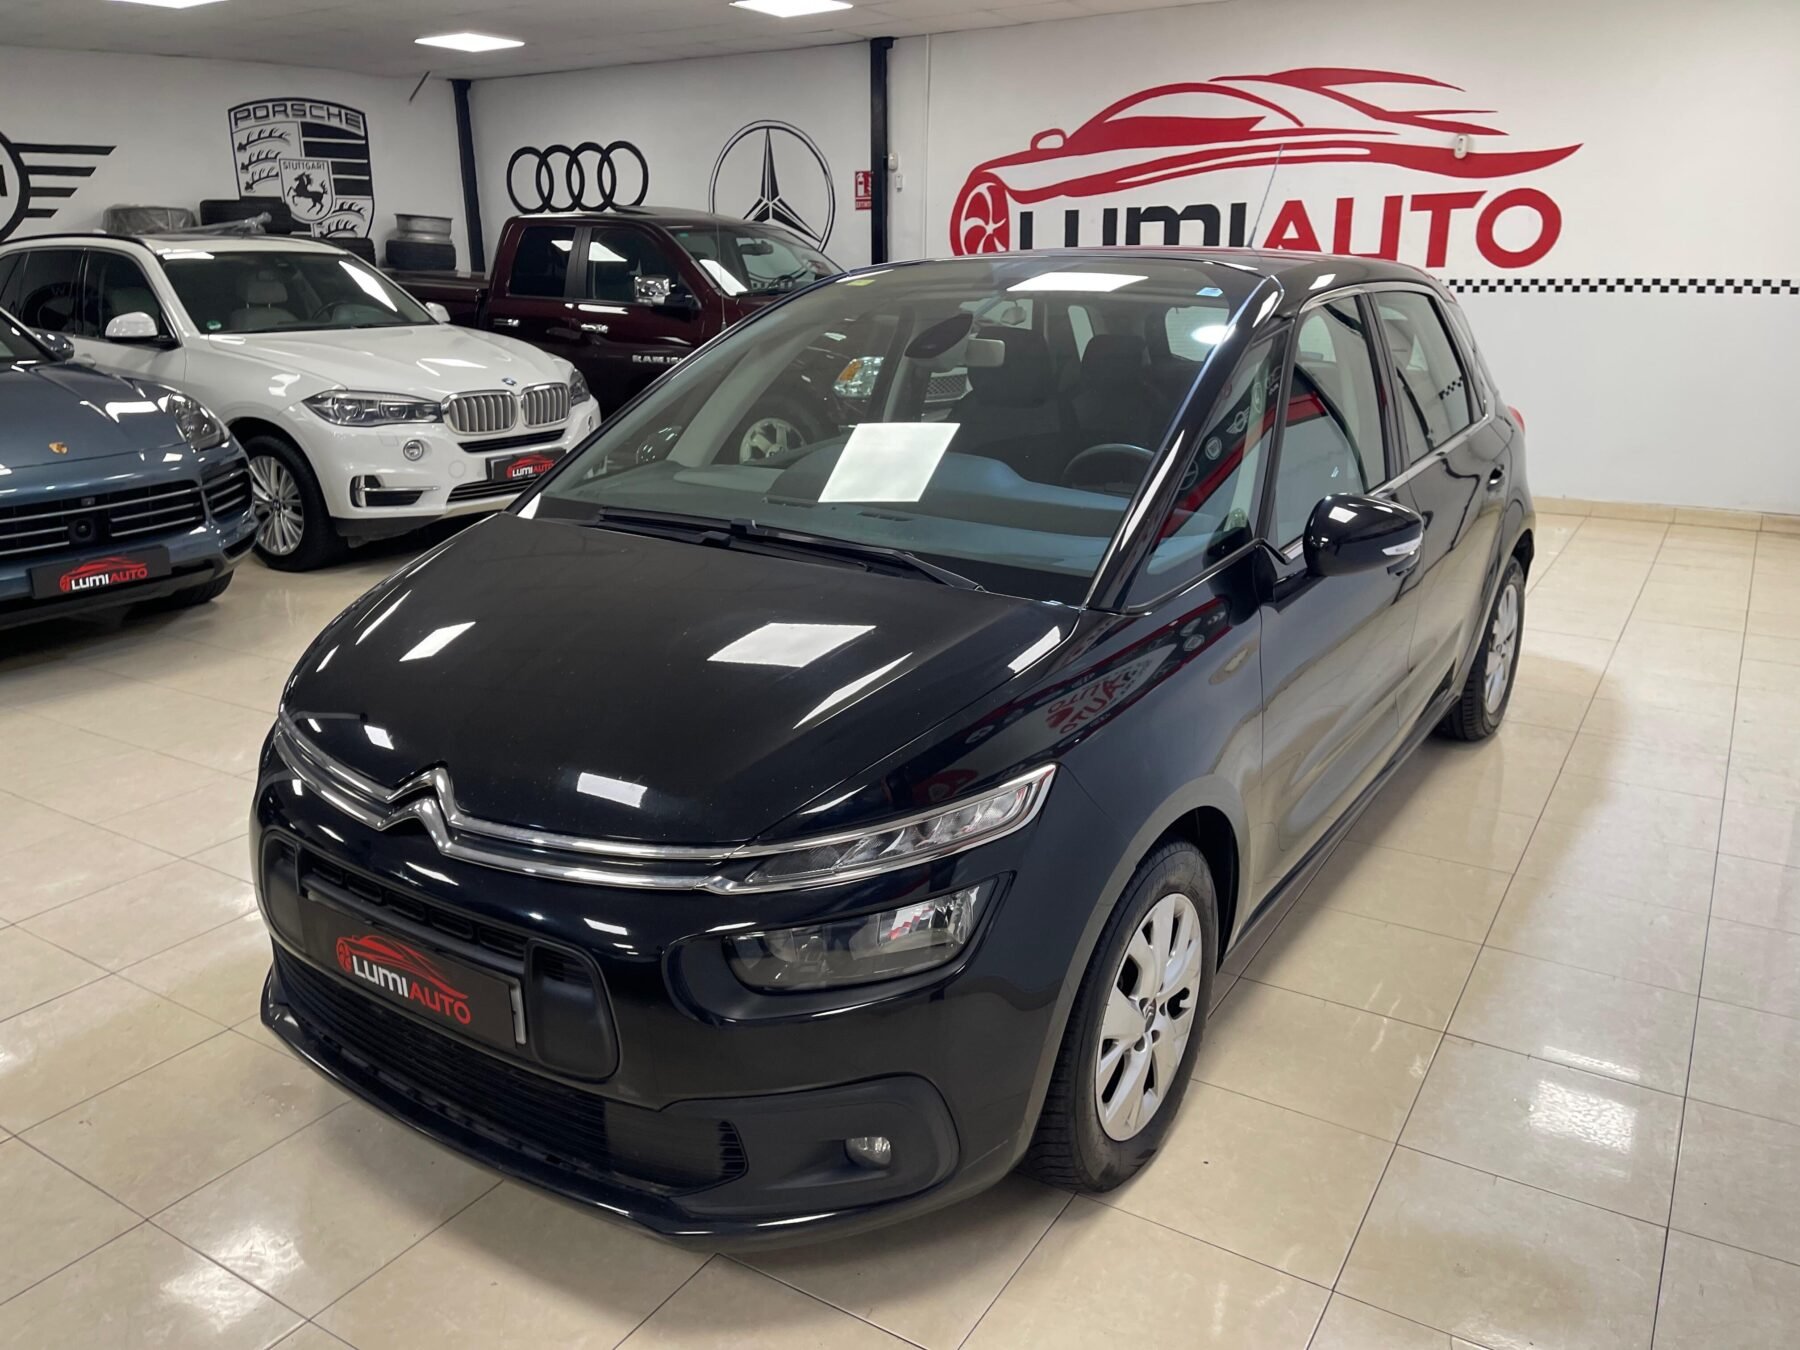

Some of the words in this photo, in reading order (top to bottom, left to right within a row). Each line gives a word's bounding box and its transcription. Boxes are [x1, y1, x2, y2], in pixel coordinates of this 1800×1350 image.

[233, 102, 362, 131] PORSCHE
[282, 161, 327, 171] STUTTGART
[632, 354, 664, 363] RAM
[71, 568, 148, 590] LUMIAUTO
[352, 955, 472, 1025] LUMIAUTO
